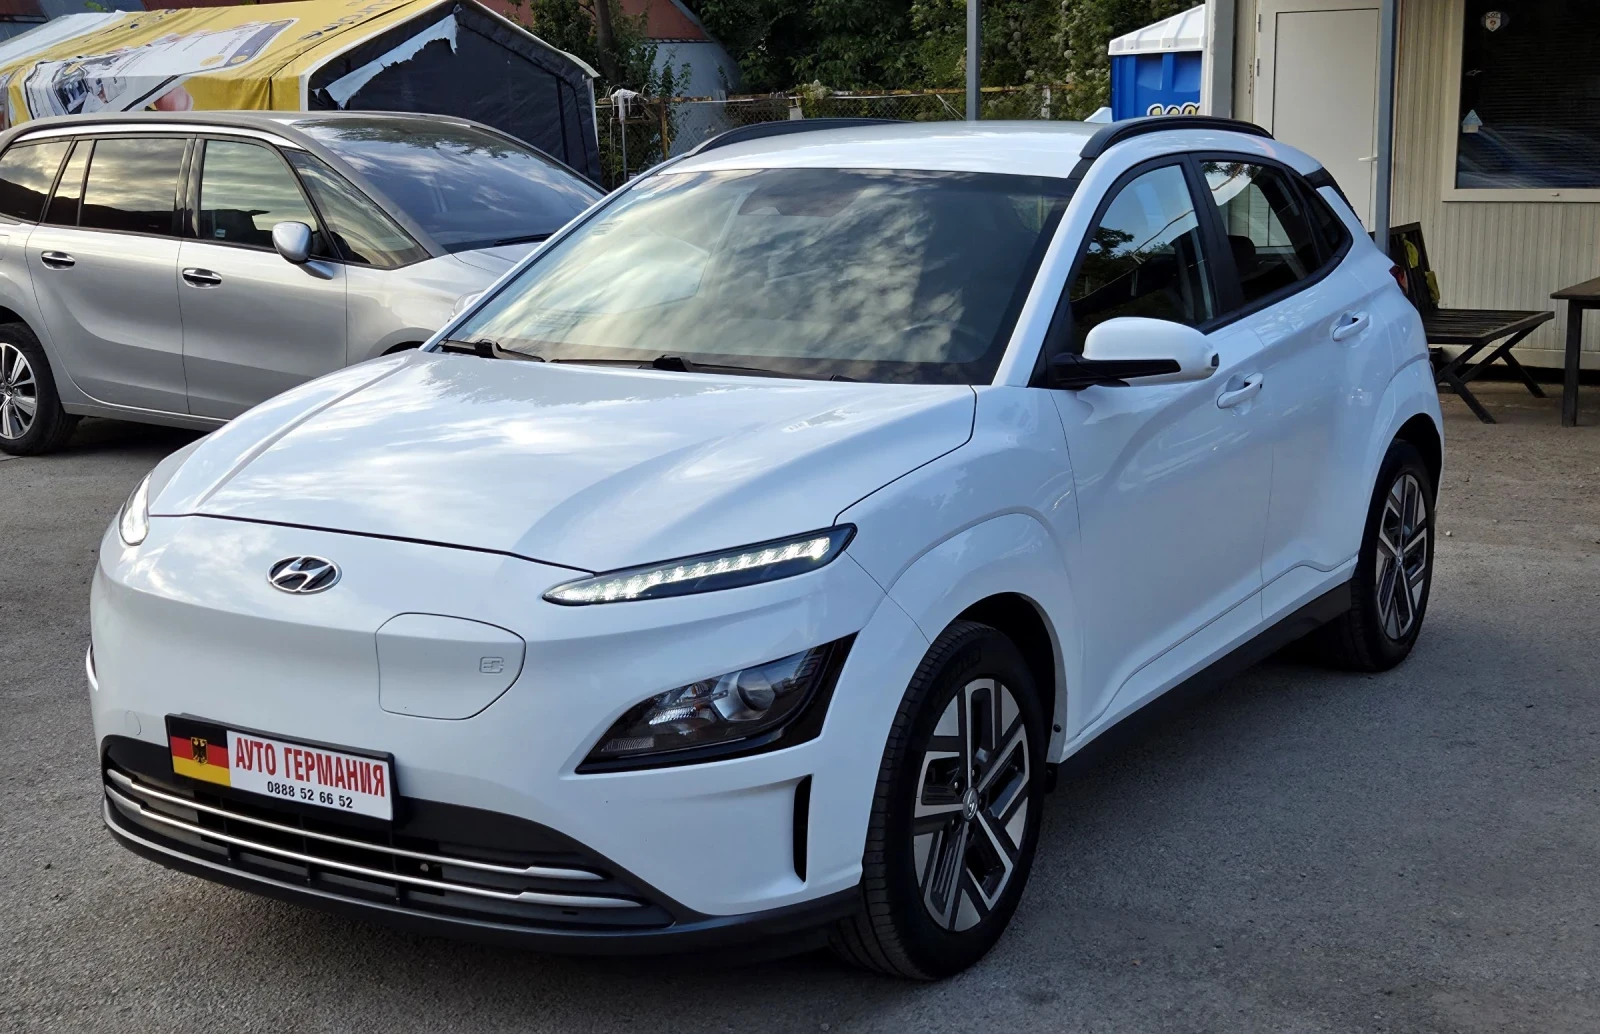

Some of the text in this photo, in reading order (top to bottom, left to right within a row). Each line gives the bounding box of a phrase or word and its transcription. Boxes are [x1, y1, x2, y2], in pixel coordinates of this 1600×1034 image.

[236, 738, 384, 796] АУТО ГЕРМАНИЯ
[267, 781, 353, 809] 0888 52 66 52
